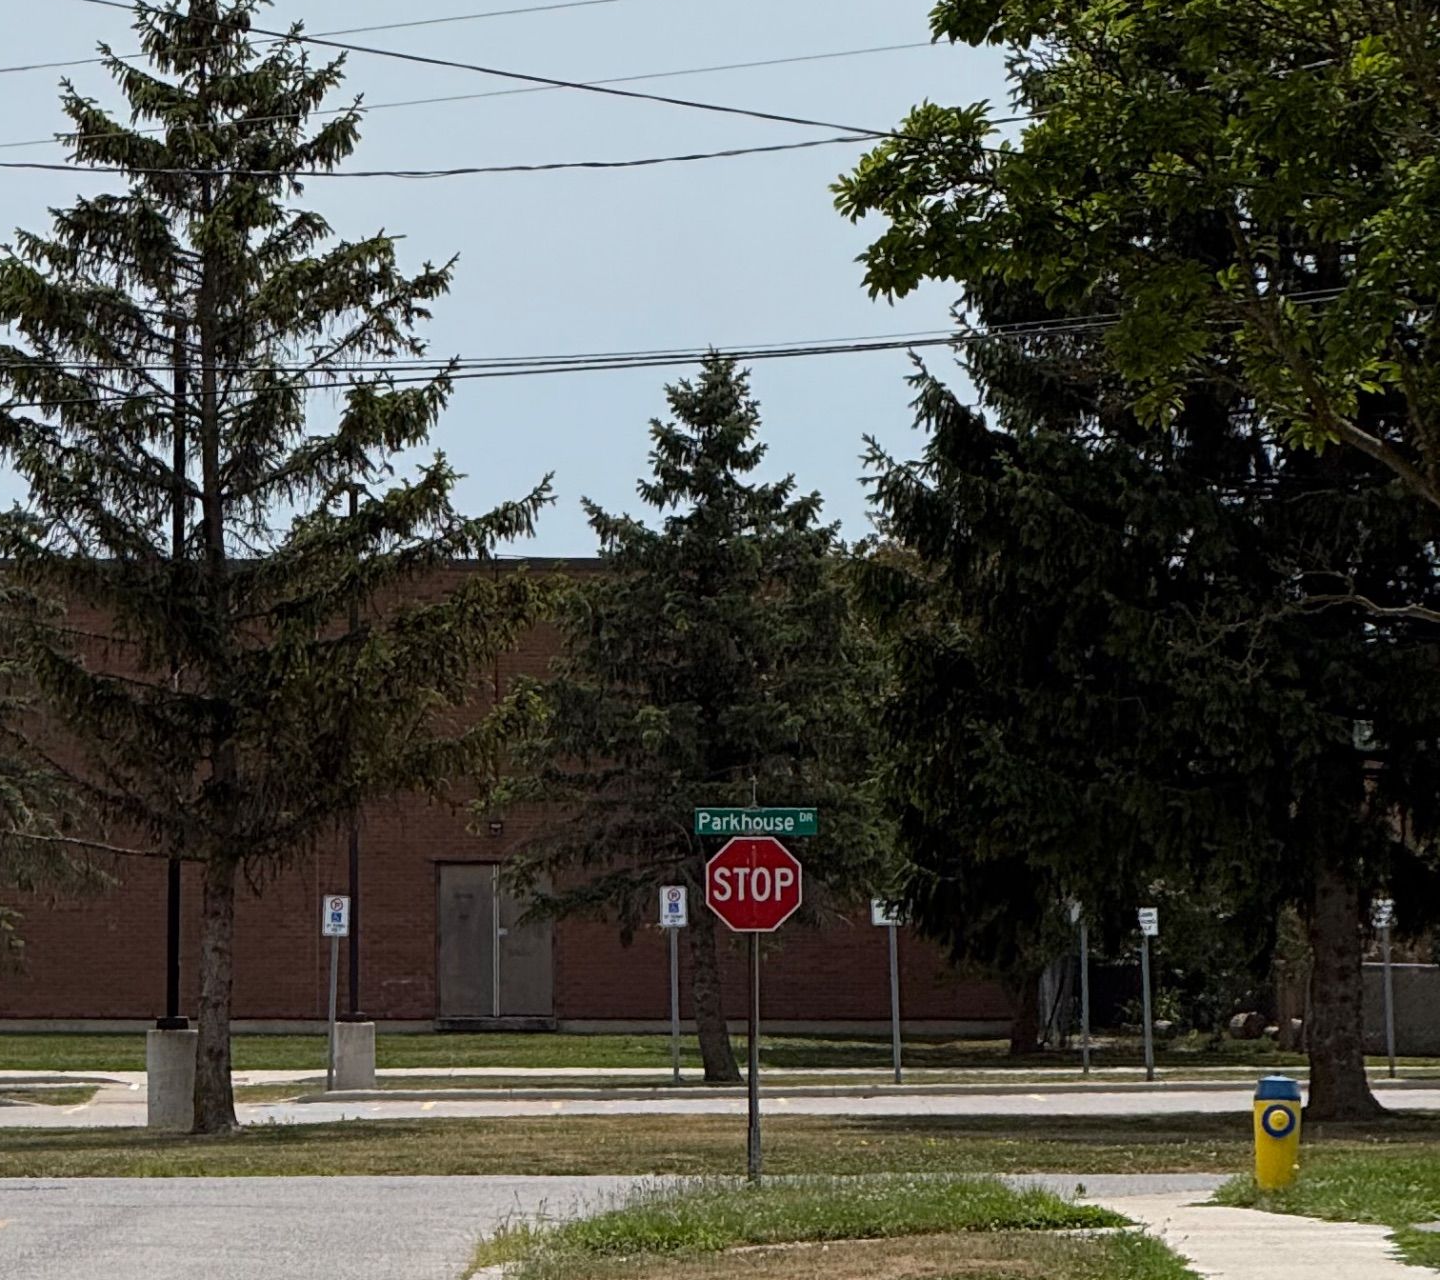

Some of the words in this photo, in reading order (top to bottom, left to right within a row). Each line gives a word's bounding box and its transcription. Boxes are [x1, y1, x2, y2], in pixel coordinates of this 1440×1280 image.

[698, 812, 795, 831] Parkhouse
[799, 812, 813, 823] DR
[713, 866, 794, 902] STOP
